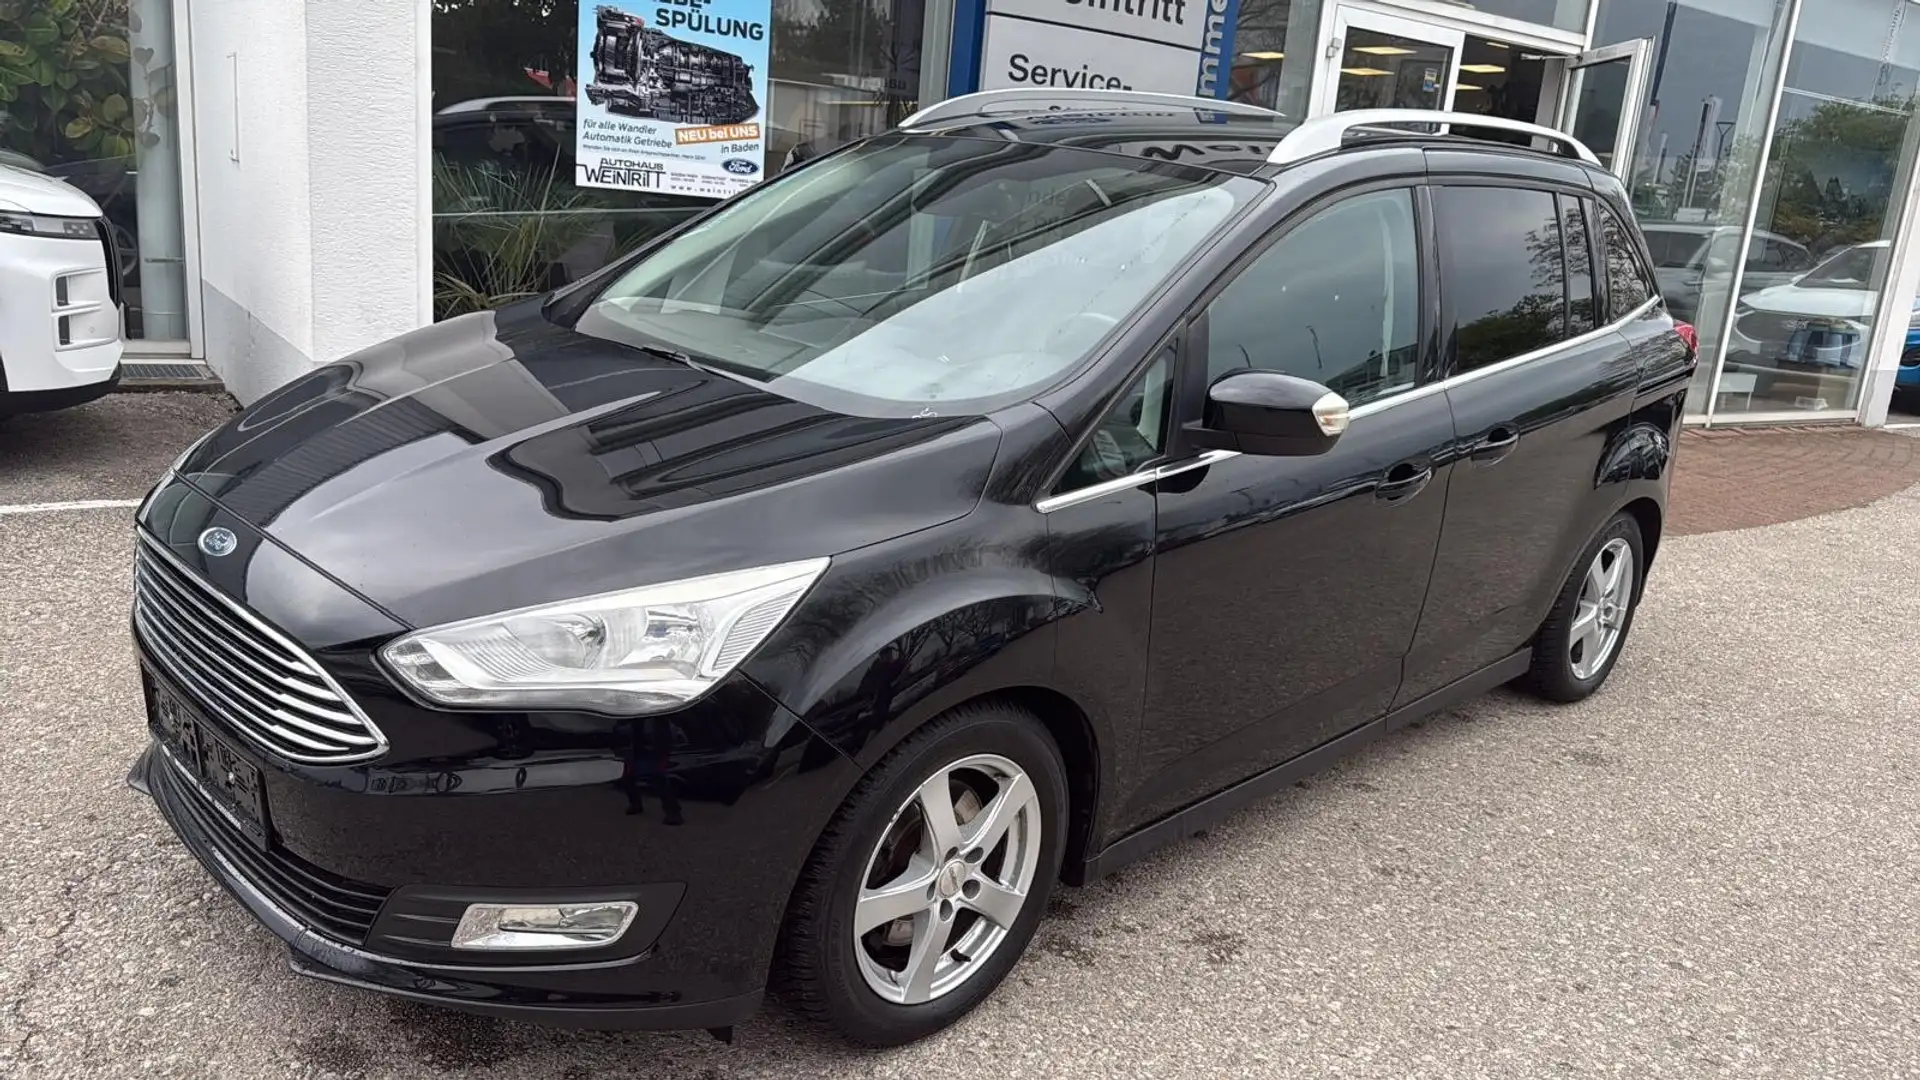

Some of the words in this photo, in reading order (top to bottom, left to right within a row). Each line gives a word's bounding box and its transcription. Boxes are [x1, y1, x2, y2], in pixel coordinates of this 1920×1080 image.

[1066, 0, 1186, 25] tritt
[656, 8, 764, 41] SPÜLUNG
[1008, 53, 1133, 91] Service-
[583, 118, 597, 129] für
[598, 121, 616, 130] alle
[618, 122, 657, 135] Wandler
[678, 128, 707, 142] NEU
[730, 124, 758, 138] UNS
[583, 131, 632, 144] Automatik
[633, 136, 673, 149] Getriebe
[721, 143, 729, 154] in
[731, 142, 759, 153] Baden
[601, 157, 664, 171] AUTOHAUS
